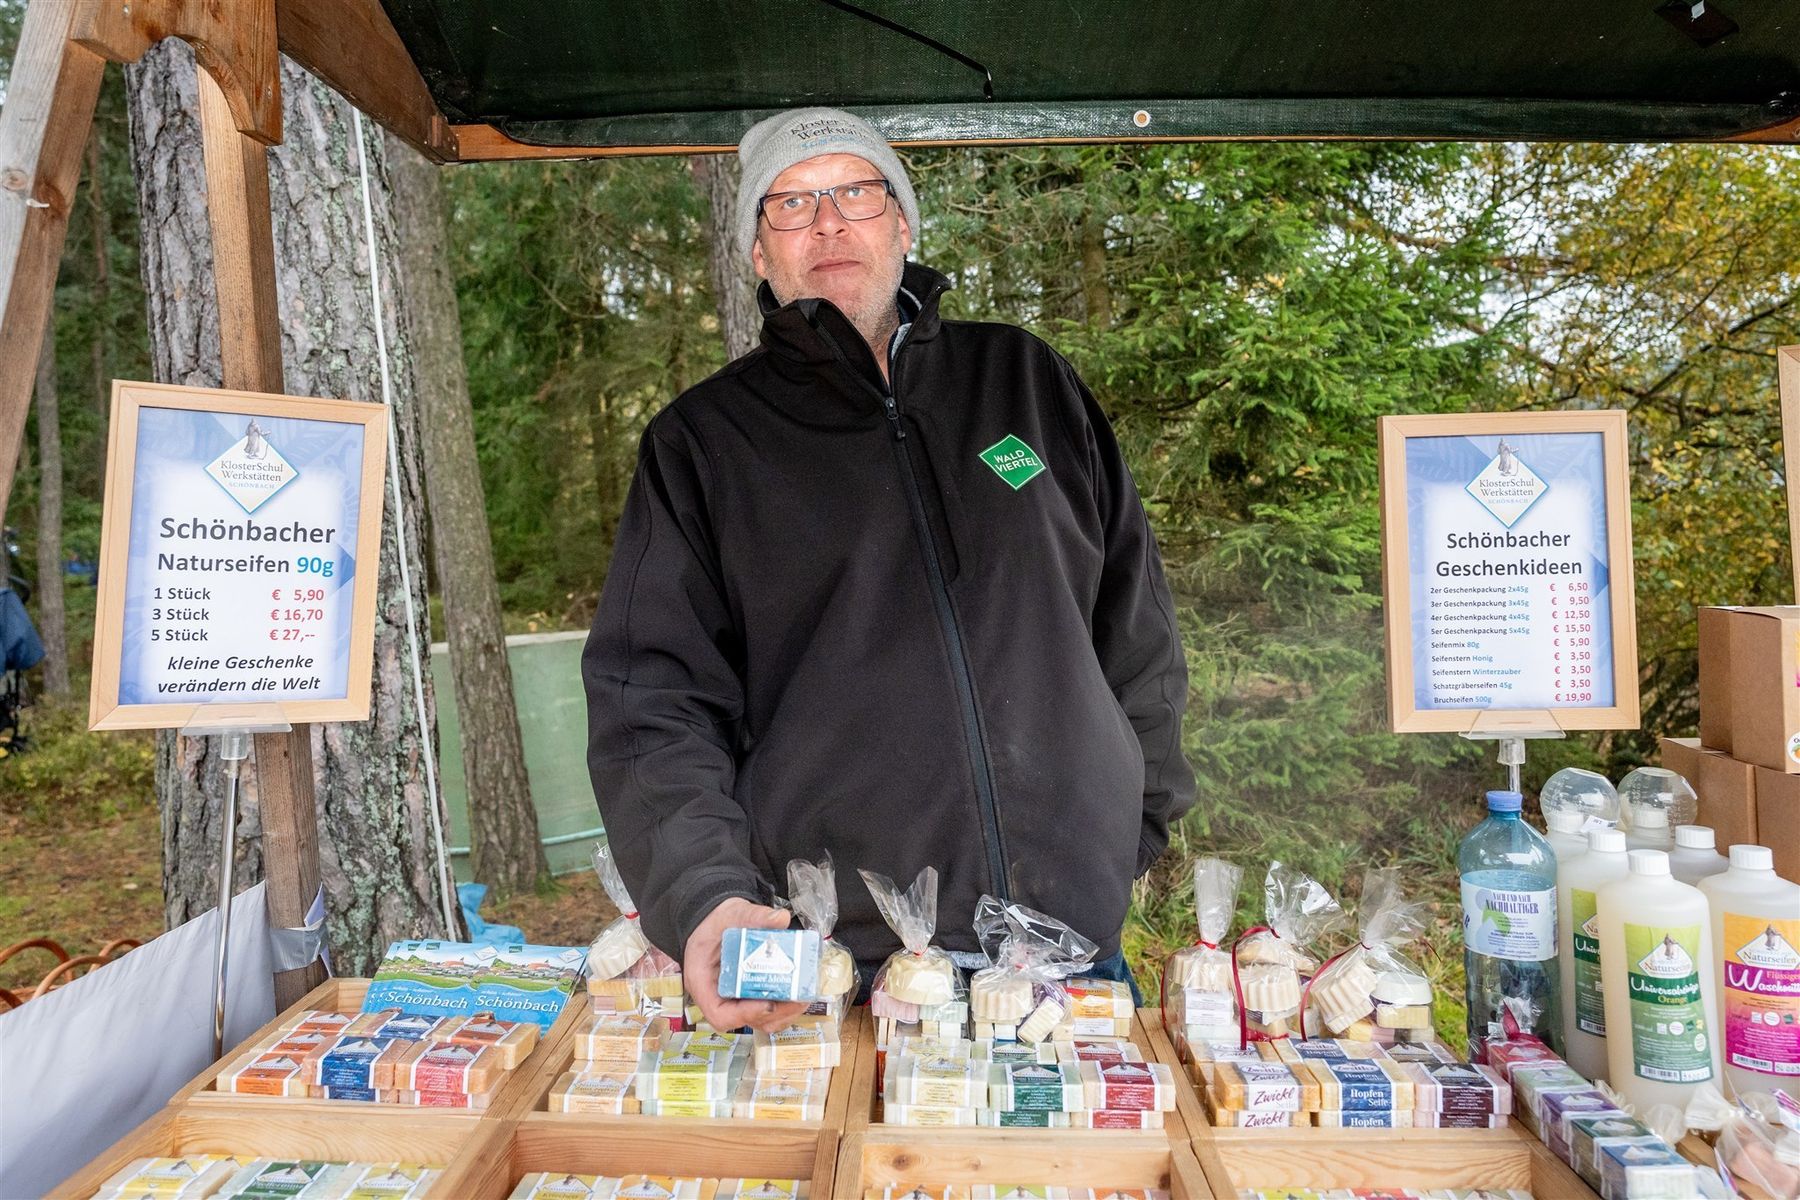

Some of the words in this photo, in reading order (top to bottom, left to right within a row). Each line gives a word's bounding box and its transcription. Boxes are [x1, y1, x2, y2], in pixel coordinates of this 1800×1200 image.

[993, 450, 1025, 463] WALD
[221, 460, 283, 472] KlosterSchul
[995, 457, 1038, 472] VIERTEL
[221, 470, 281, 481] Werkstätten
[1480, 478, 1534, 488] KlosterSchul
[1481, 488, 1534, 497] Werkstätten
[160, 517, 336, 544] Schönbacher
[1447, 531, 1570, 549] Schönbacher
[158, 553, 289, 573] Naturseifen
[296, 556, 334, 577] 90g
[1436, 559, 1582, 577] Geschenkideen
[154, 588, 161, 599] 1
[168, 587, 211, 600] Stück
[272, 590, 281, 600] €
[294, 589, 324, 602] 5,90
[1443, 586, 1506, 594] Geschenkpackung
[1508, 586, 1529, 594] 2x45g
[1550, 584, 1556, 592] €
[1568, 583, 1588, 592] 6,50
[1444, 600, 1507, 608] Geschenkpackung
[1508, 600, 1529, 608] 3x45g
[1551, 597, 1557, 605] €
[1569, 596, 1589, 606] 9,50
[152, 609, 161, 620] 3
[166, 608, 210, 621] Stück
[271, 609, 280, 620] €
[284, 609, 323, 622] 16,70
[1508, 613, 1530, 621] 4x45g
[1552, 611, 1558, 619] €
[1565, 610, 1590, 619] 12,50
[151, 630, 160, 641] 5
[165, 629, 208, 641] Stück
[269, 630, 278, 640] €
[282, 630, 315, 643] 27,--
[1444, 627, 1507, 635] Geschenkpackung
[1509, 627, 1530, 635] 5x45g
[1553, 625, 1559, 633] €
[1565, 624, 1591, 634] 15,50
[1554, 639, 1560, 647] €
[1570, 638, 1590, 647] 5,90
[168, 656, 219, 670] kleine
[225, 655, 313, 670] Geschenke
[1554, 652, 1560, 660] €
[1570, 652, 1591, 661] 3,50
[1472, 668, 1521, 676] Winterzauber
[1555, 666, 1561, 674] €
[1571, 665, 1591, 675] 3,50
[158, 680, 246, 694] verändern
[252, 677, 276, 691] die
[283, 676, 320, 690] Welt
[1433, 682, 1497, 690] Schatzgräberseifen
[1499, 682, 1512, 690] 45g
[1555, 680, 1561, 688] €
[1570, 679, 1591, 689] 3,50
[1434, 696, 1474, 704] Bruchseifen
[1475, 696, 1492, 704] 500g
[1555, 694, 1561, 702] €
[1565, 693, 1591, 702] 19,90
[1493, 892, 1506, 901] NACH
[1507, 893, 1517, 902] UND
[1518, 894, 1531, 902] NACH
[1486, 899, 1539, 914] NACHHALTIGER
[384, 991, 468, 1009] Schönbach
[475, 995, 559, 1013] Schönbach
[1254, 1087, 1296, 1106] Zwickl
[1350, 1088, 1384, 1102] Hopfen
[1368, 1098, 1389, 1107] Seife
[1245, 1111, 1286, 1128] Zwickl
[1350, 1117, 1384, 1128] Hopfen
